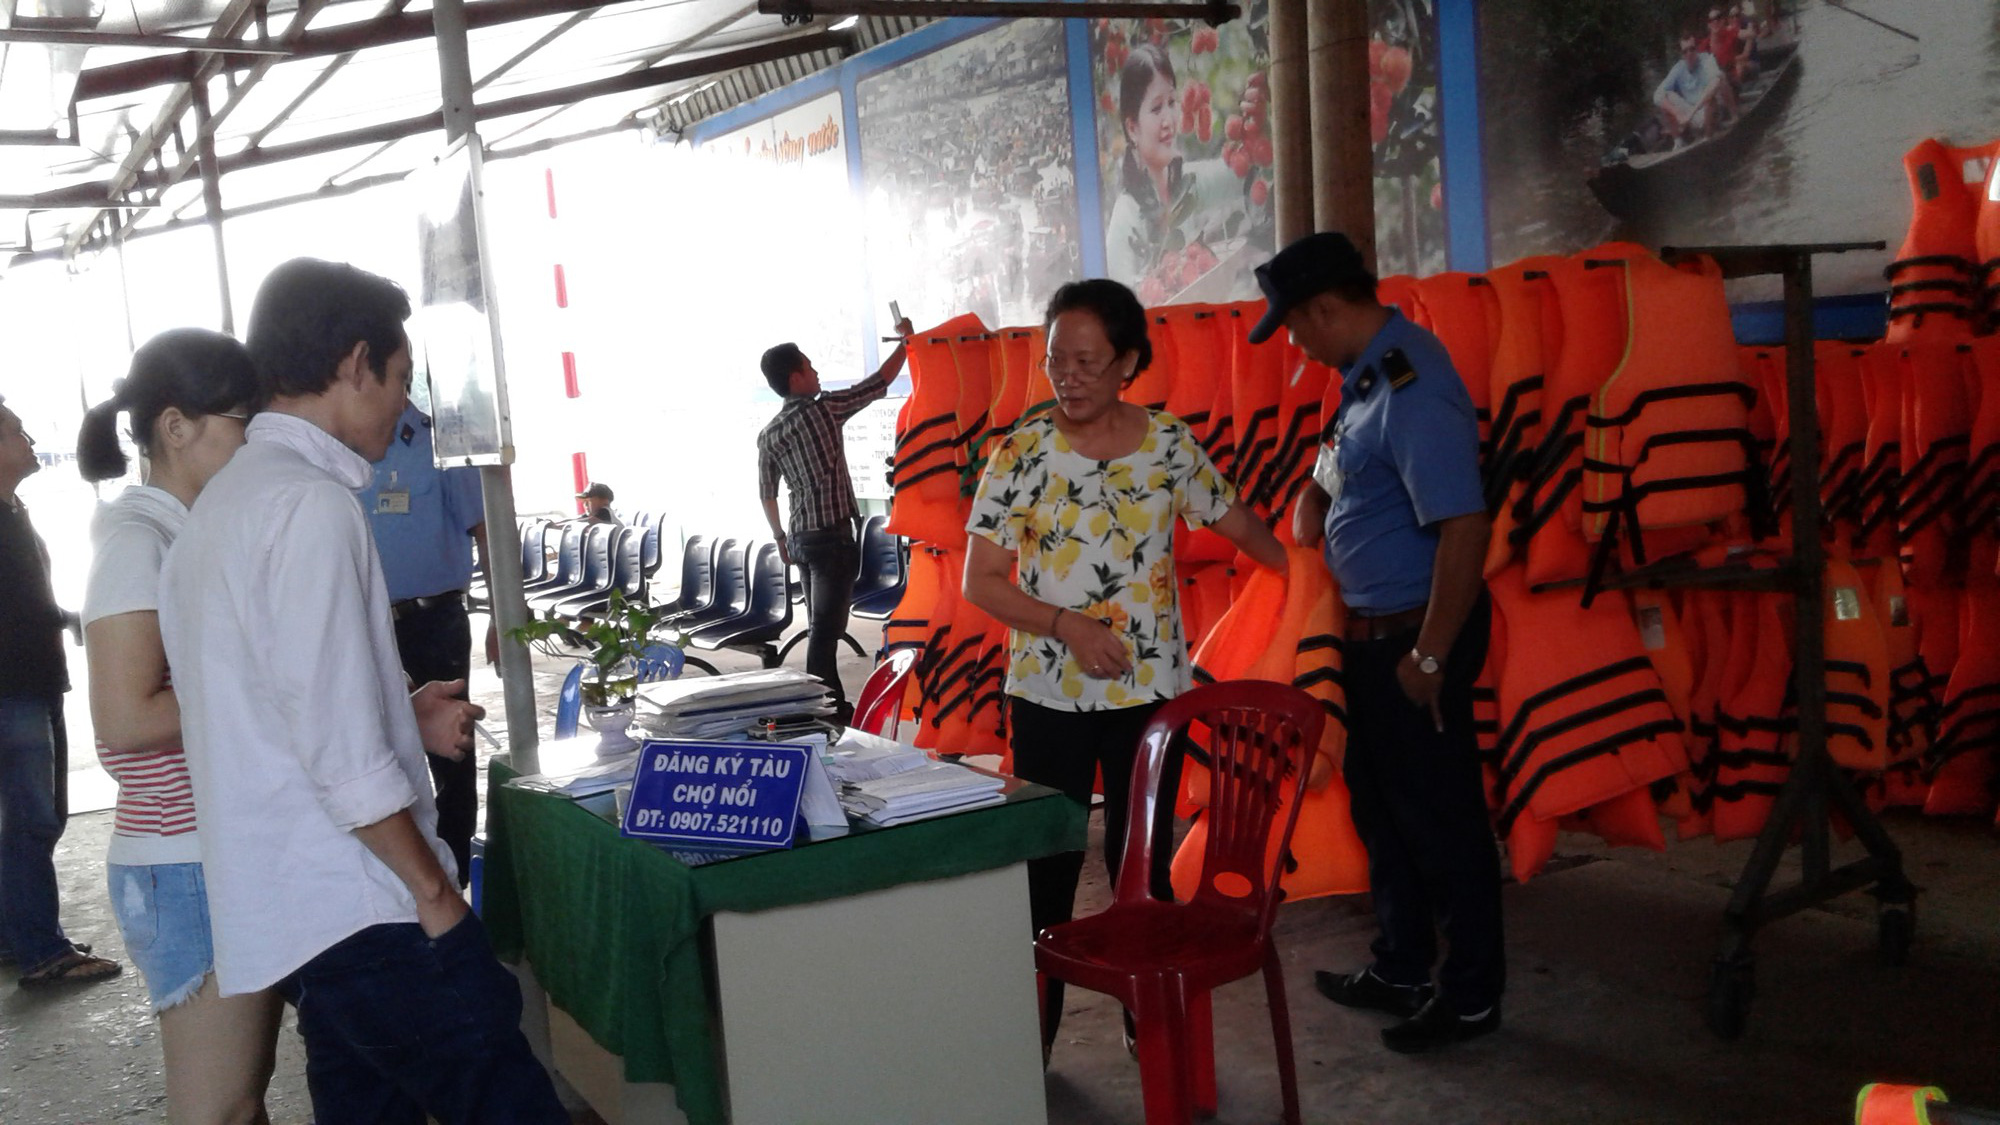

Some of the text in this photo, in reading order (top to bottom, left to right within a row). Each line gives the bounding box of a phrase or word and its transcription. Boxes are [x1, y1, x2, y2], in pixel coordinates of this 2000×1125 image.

[653, 751, 791, 778] ĐĂNG KÝ TÀU
[672, 779, 757, 809] CHỢ NỔI
[636, 809, 783, 837] ĐT: 0907.521110
